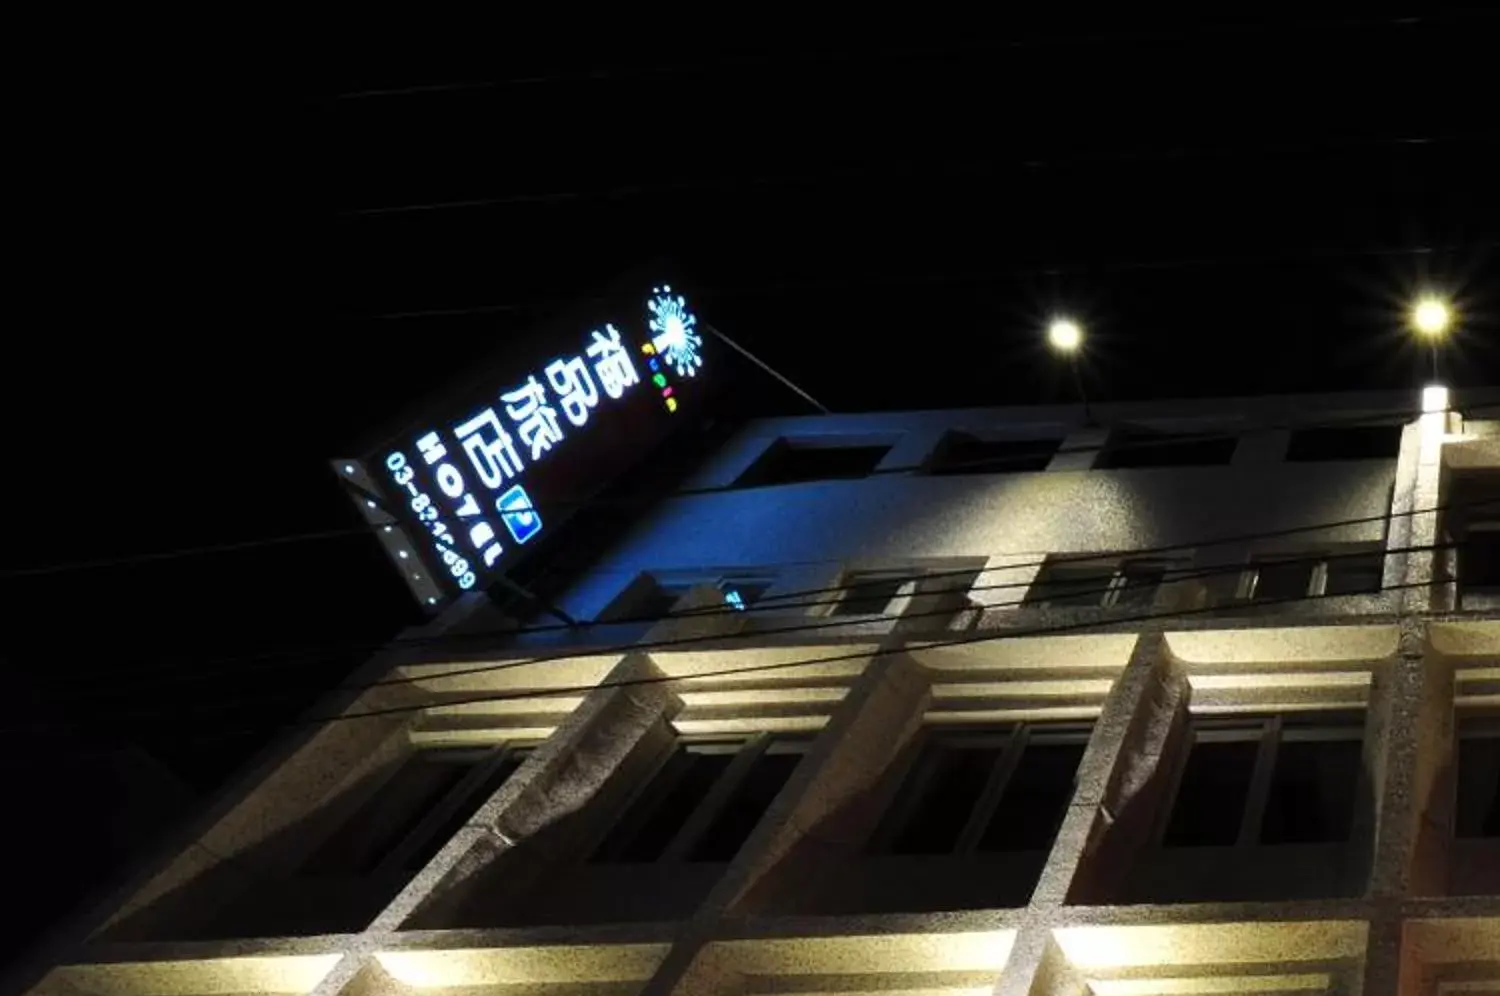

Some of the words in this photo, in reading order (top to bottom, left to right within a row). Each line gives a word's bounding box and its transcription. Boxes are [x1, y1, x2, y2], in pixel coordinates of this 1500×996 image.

[453, 323, 641, 489] 福品旅店
[415, 431, 504, 567] HOTEL
